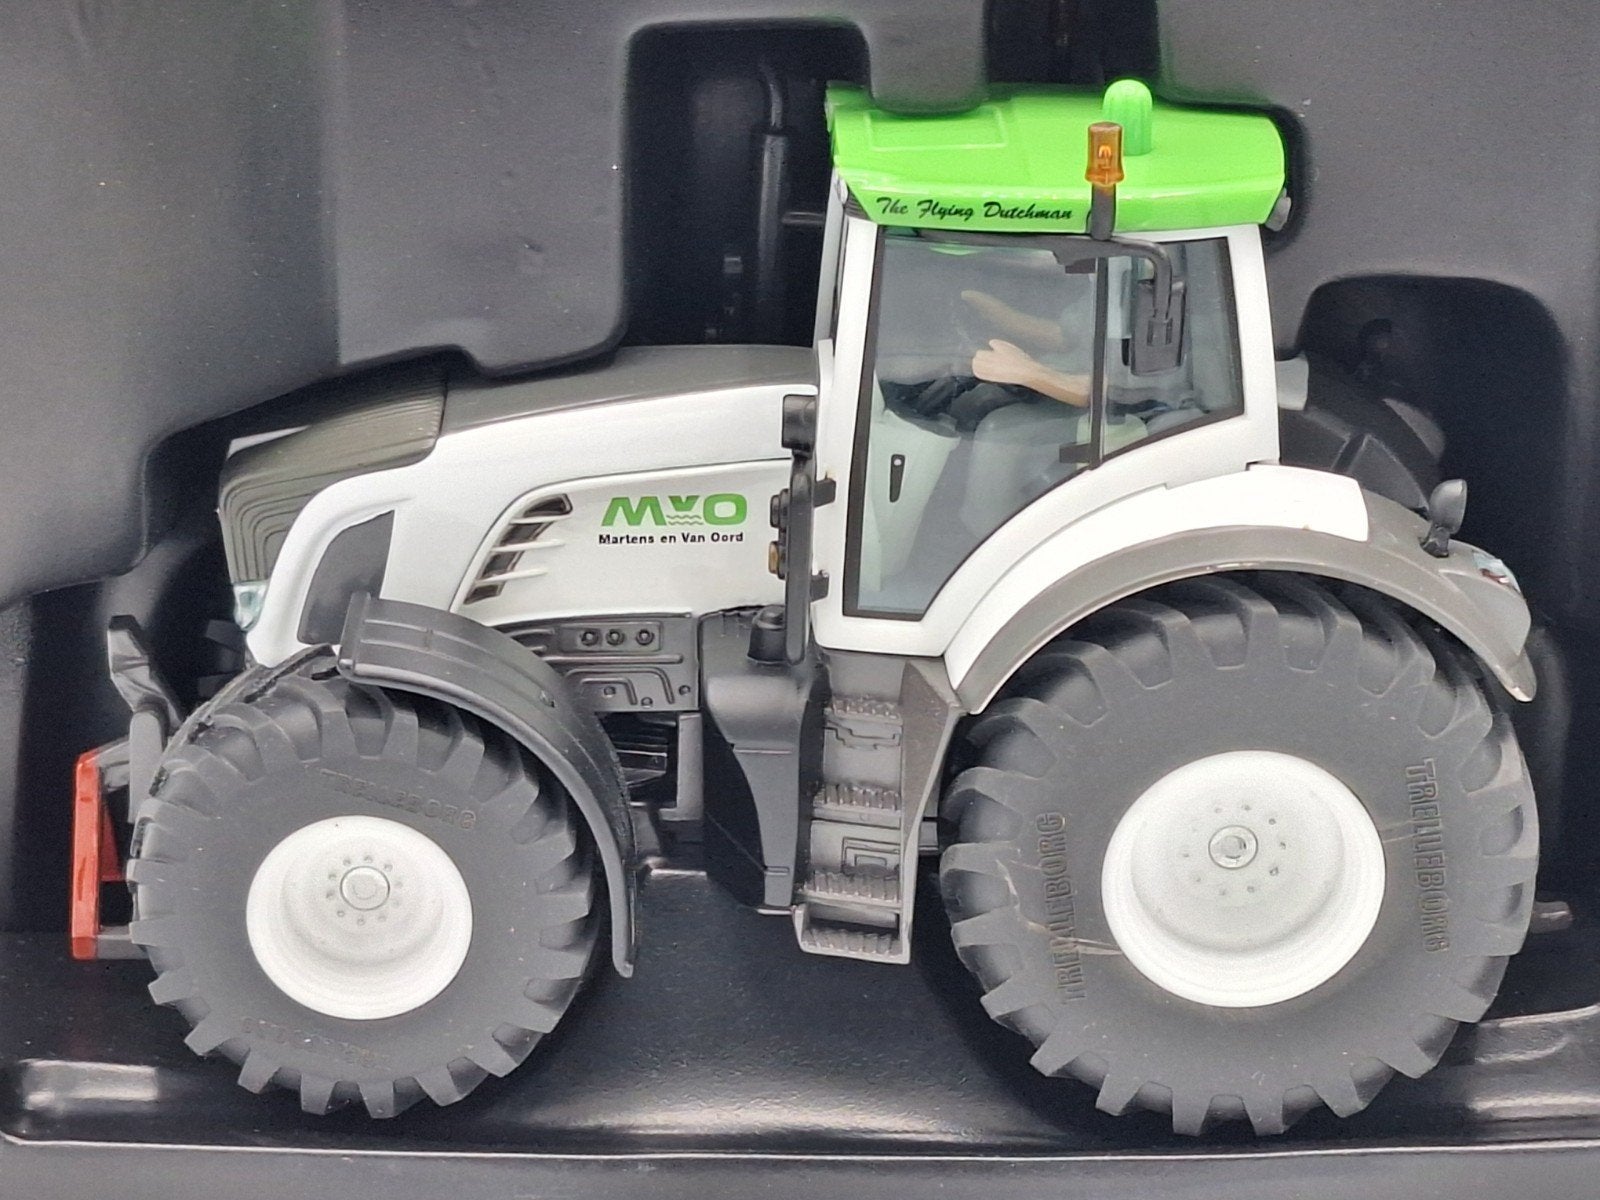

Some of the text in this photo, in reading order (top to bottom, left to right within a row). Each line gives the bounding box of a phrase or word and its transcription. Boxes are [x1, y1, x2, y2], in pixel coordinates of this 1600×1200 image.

[876, 197, 1072, 221] The Flying Dutchman
[599, 532, 744, 544] Martens en Van Oord
